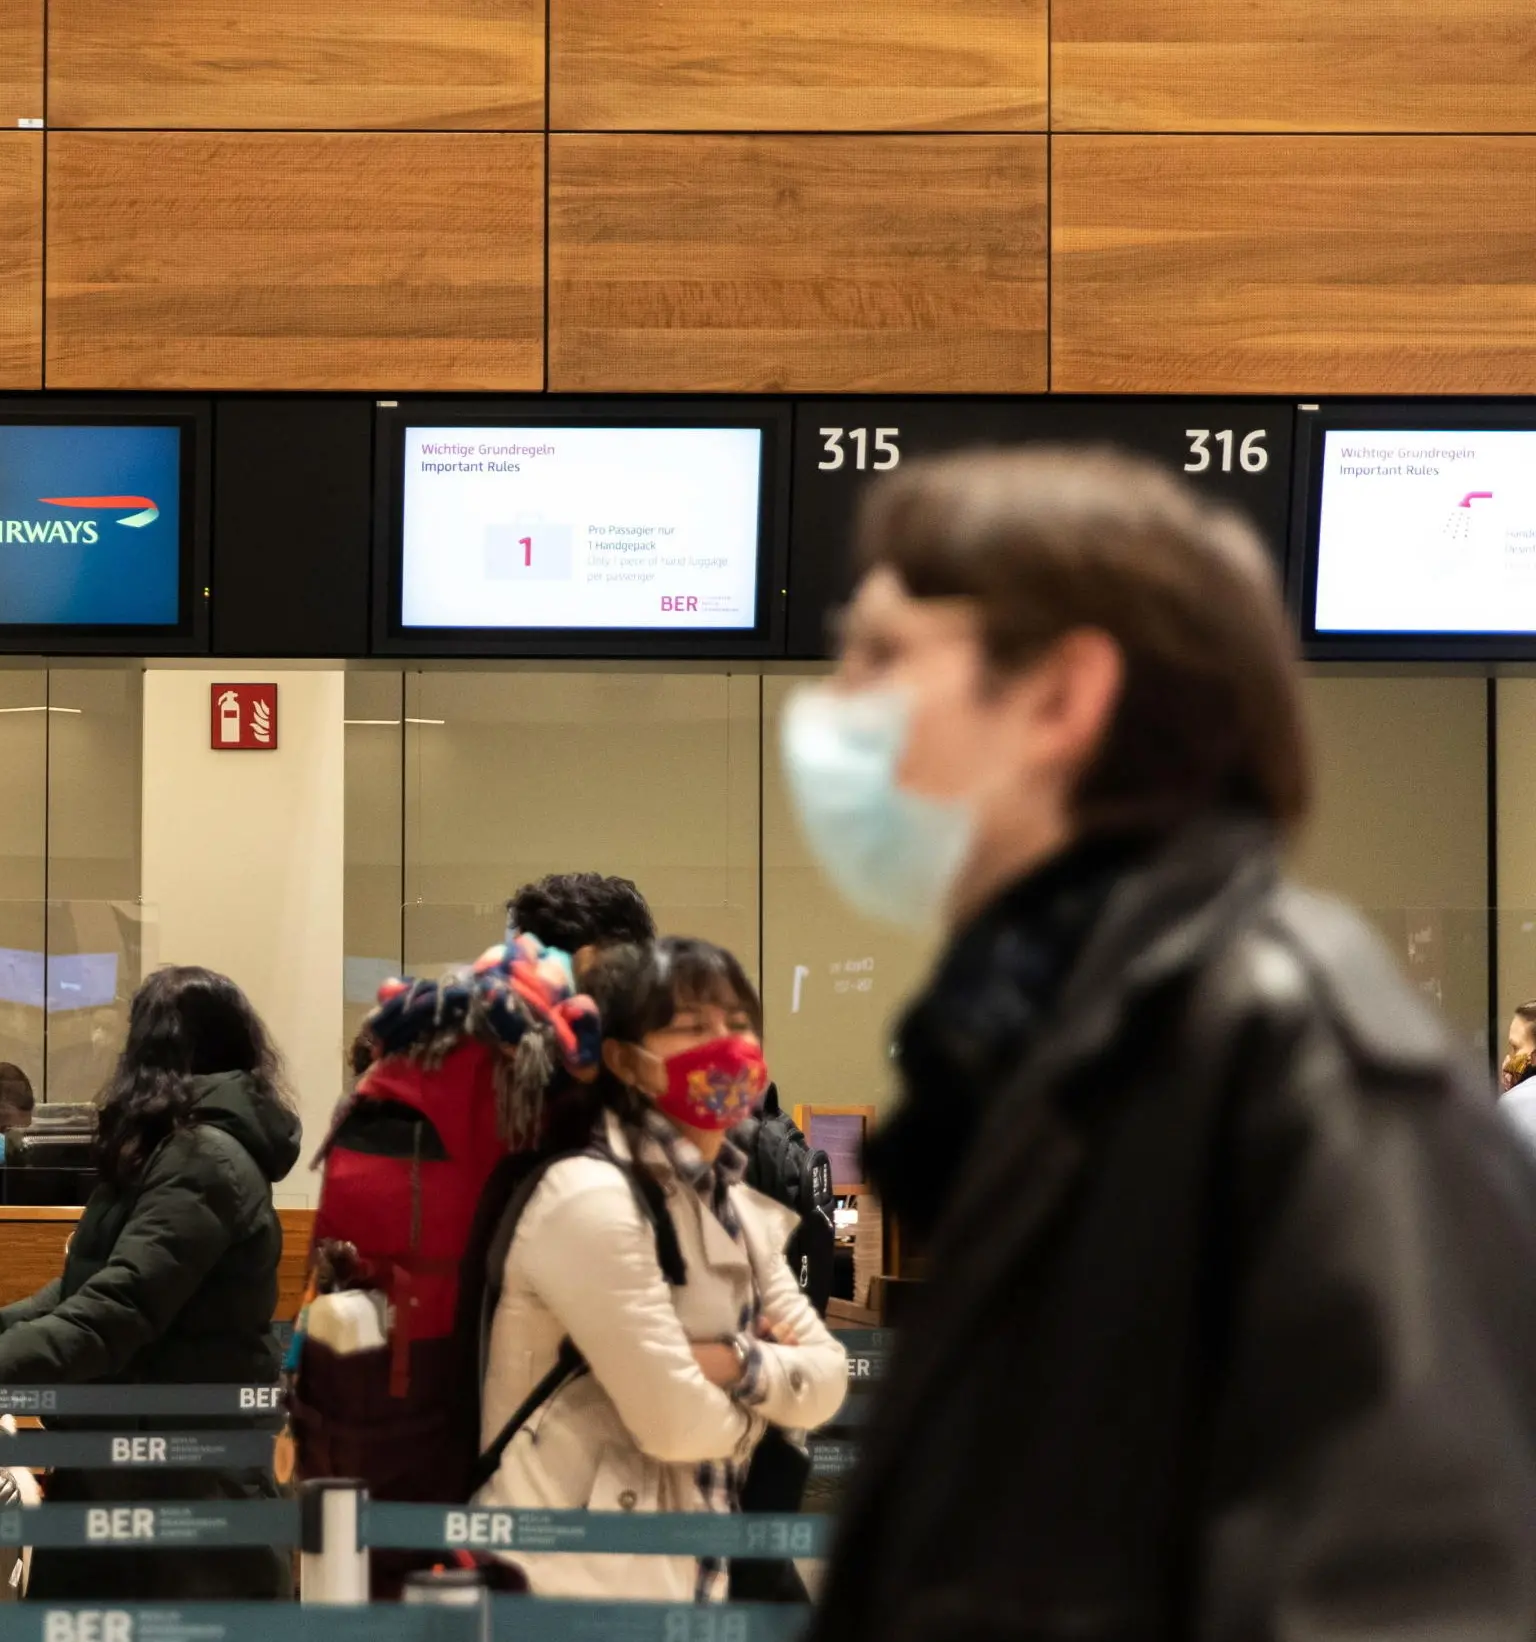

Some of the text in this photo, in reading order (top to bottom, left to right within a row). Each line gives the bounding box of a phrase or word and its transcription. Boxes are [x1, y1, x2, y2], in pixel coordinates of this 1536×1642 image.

[421, 444, 555, 458] Wichtige Grundregeln
[818, 428, 901, 471] 315
[1184, 430, 1269, 472] 316
[1340, 448, 1476, 461] Wichtige Grundregeln
[421, 461, 520, 474] Important Rules
[1340, 465, 1440, 477] Important Rules
[588, 525, 606, 535] Pro
[609, 525, 654, 537] Passagier
[518, 537, 533, 566] 1
[661, 596, 698, 611] BER
[847, 1358, 870, 1376] ER
[112, 1437, 166, 1460] BER
[86, 1509, 155, 1539] BER
[444, 1512, 512, 1543] BER
[44, 1611, 132, 1642] BER
